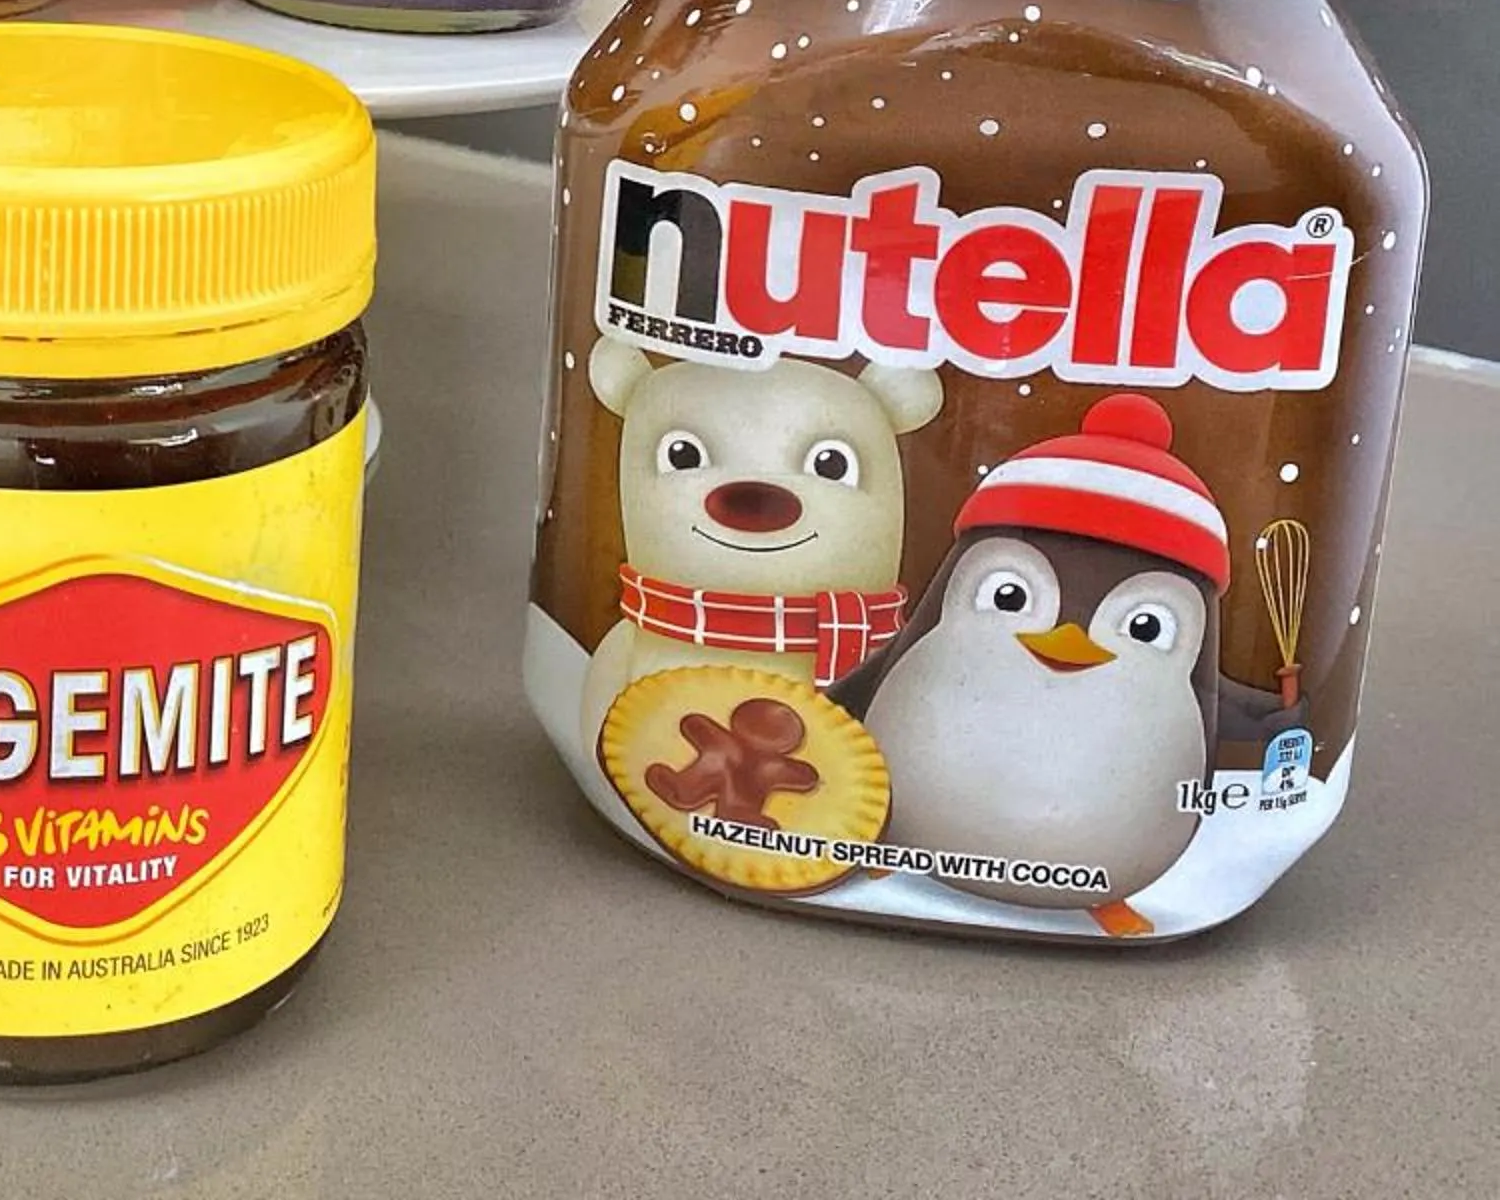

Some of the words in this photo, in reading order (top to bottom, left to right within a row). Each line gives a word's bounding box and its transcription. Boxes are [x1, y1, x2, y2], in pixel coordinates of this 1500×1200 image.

[609, 175, 1338, 374] nutella
[607, 303, 764, 359] FERRERO
[1180, 781, 1217, 816] 1kg
[3, 865, 56, 889] FOR
[65, 854, 178, 888] VITALITY
[692, 815, 828, 860] HAZELNUT
[832, 841, 934, 872] SPREAD
[938, 855, 1007, 880] WITH
[1011, 863, 1110, 891] COCOA
[41, 959, 62, 980] IN
[67, 949, 176, 979] AUSTRALIA
[180, 936, 232, 965] SINCE
[235, 912, 271, 946] 1923
